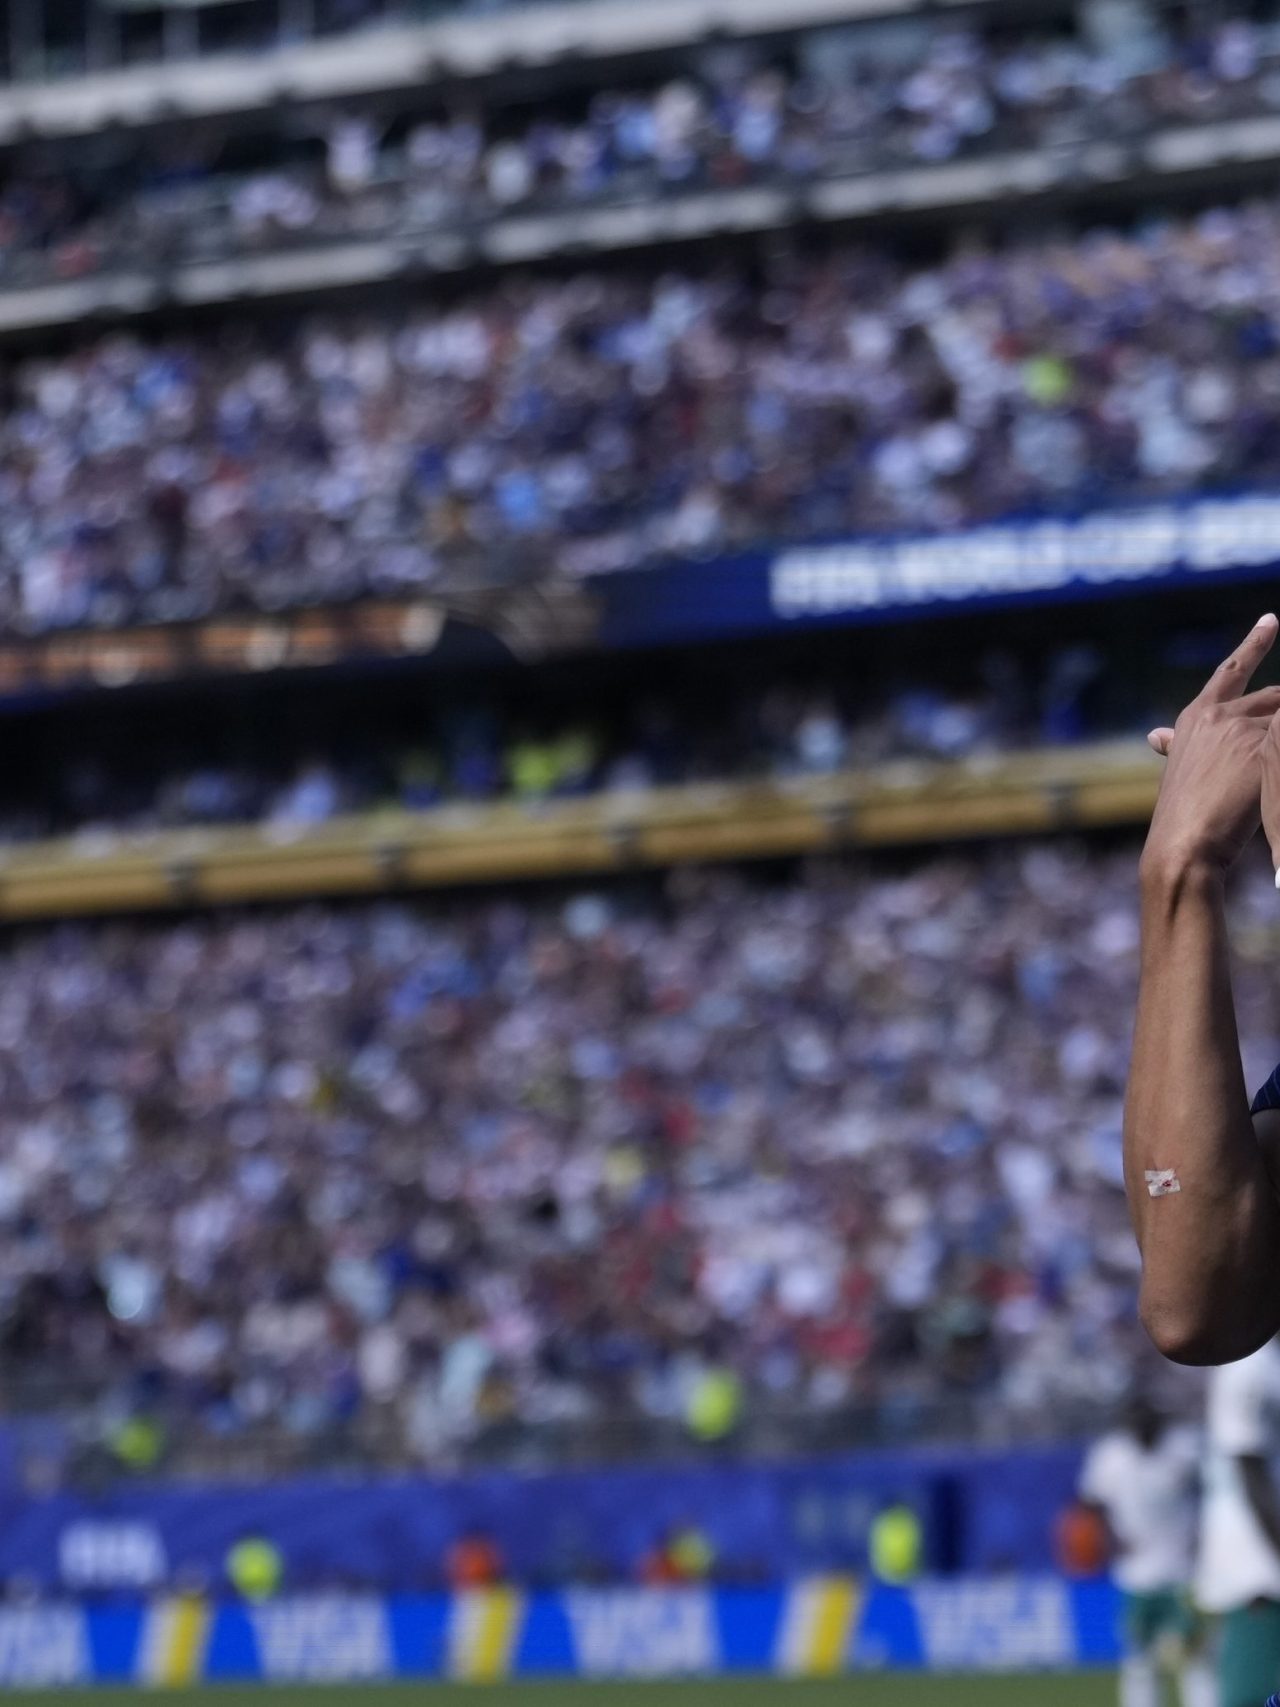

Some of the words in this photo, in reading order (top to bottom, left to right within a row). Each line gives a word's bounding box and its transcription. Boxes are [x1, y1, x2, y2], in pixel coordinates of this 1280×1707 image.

[250, 1596, 394, 1680] VISA
[567, 1587, 719, 1676] VISA
[913, 1577, 1074, 1665] VISA
